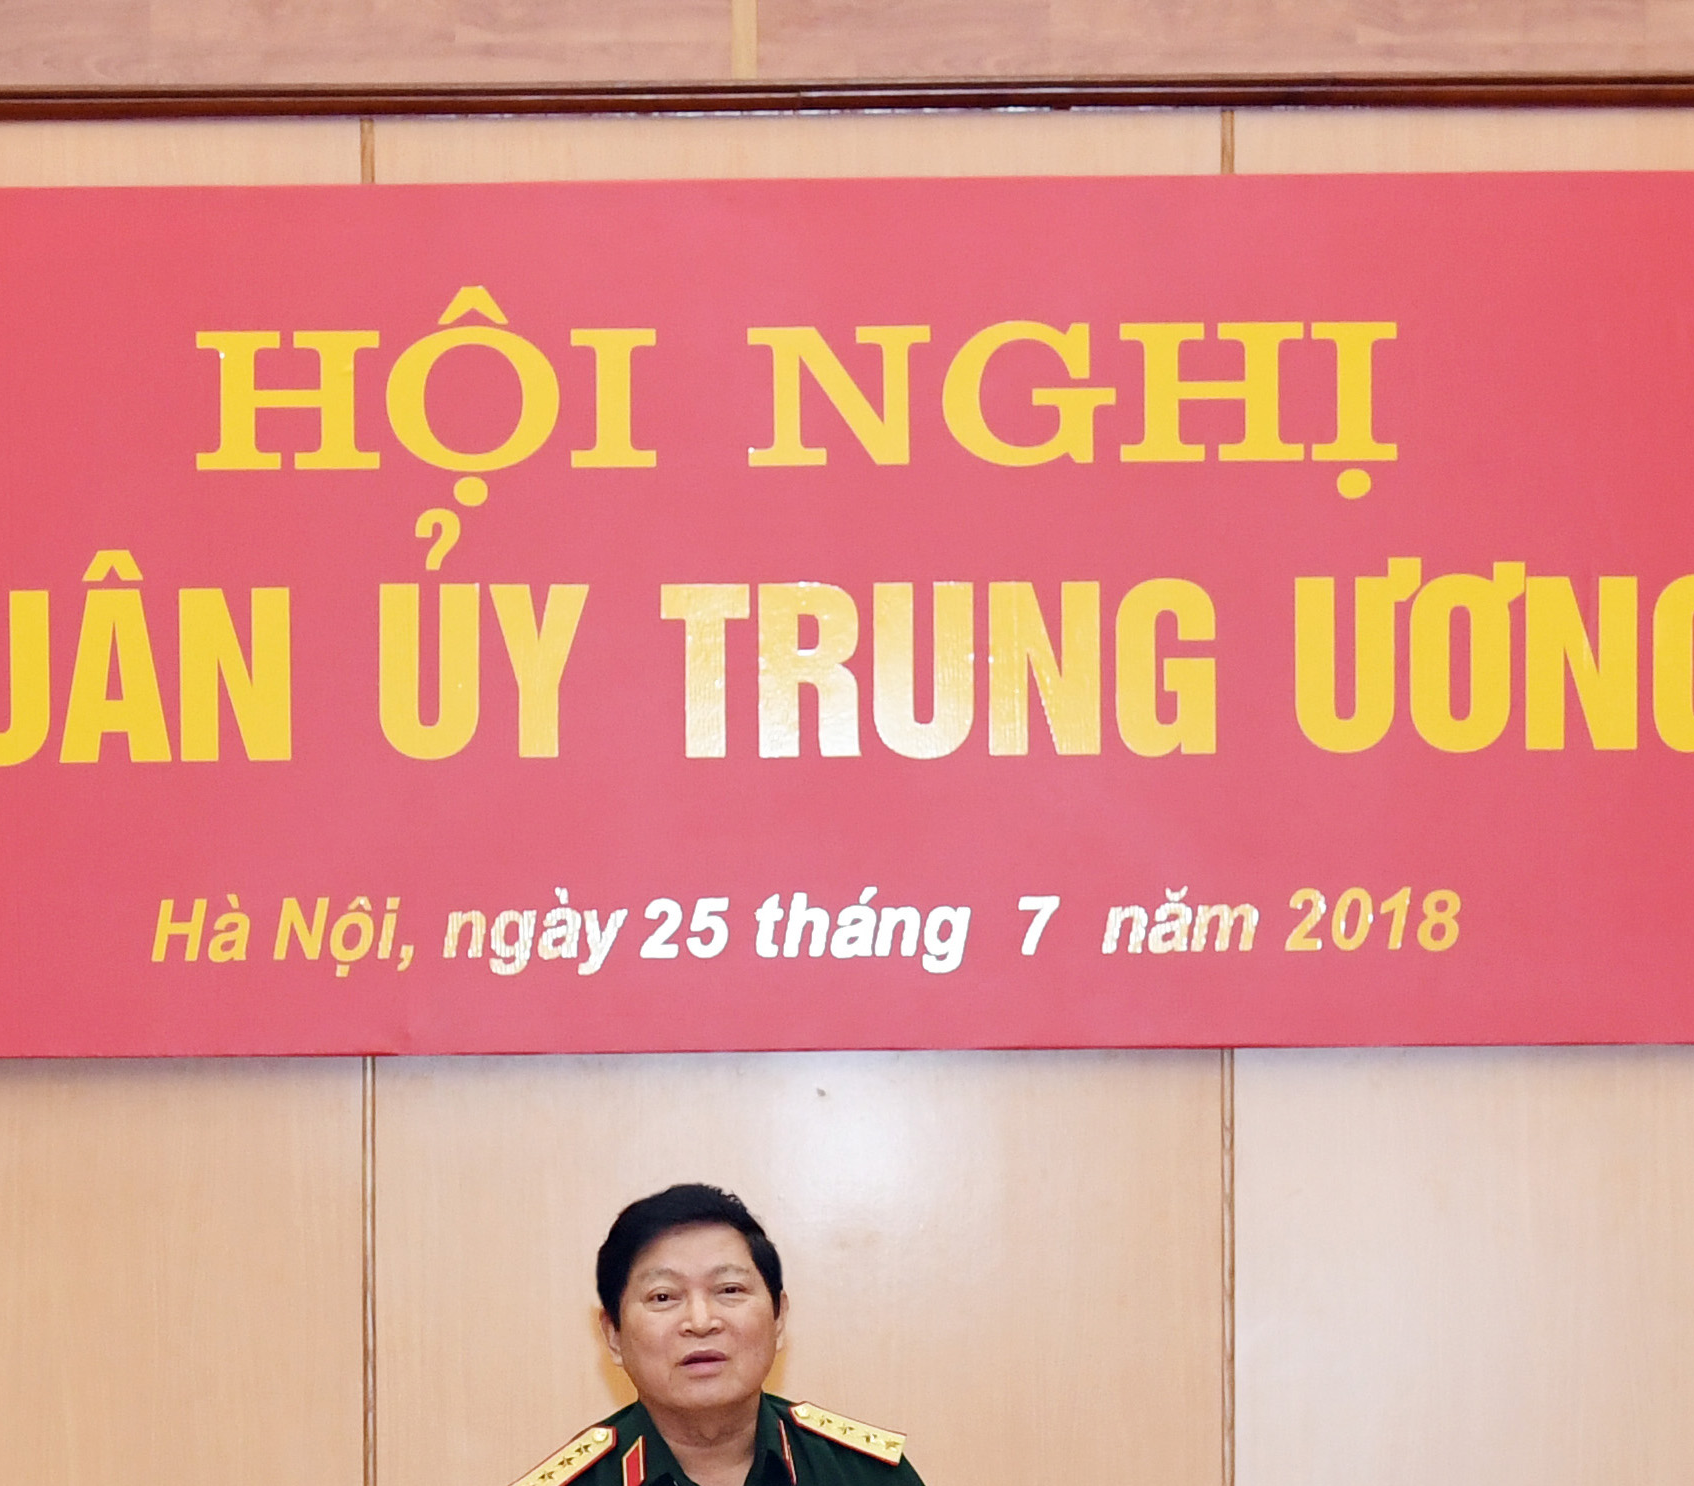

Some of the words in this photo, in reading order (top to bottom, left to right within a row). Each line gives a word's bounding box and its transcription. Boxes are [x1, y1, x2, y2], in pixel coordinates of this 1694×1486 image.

[196, 285, 657, 507] HỘI
[747, 319, 1399, 500] NGHỊ
[379, 507, 590, 760] ỦY
[660, 578, 1217, 760] TRUNG
[151, 893, 251, 963] Hà
[273, 895, 415, 978] Nội,
[443, 886, 629, 976] ngày
[640, 896, 730, 960] 25
[753, 885, 972, 974] tháng
[1017, 895, 1061, 956] 7
[1102, 885, 1260, 955] năm
[1285, 886, 1462, 952] 2018
